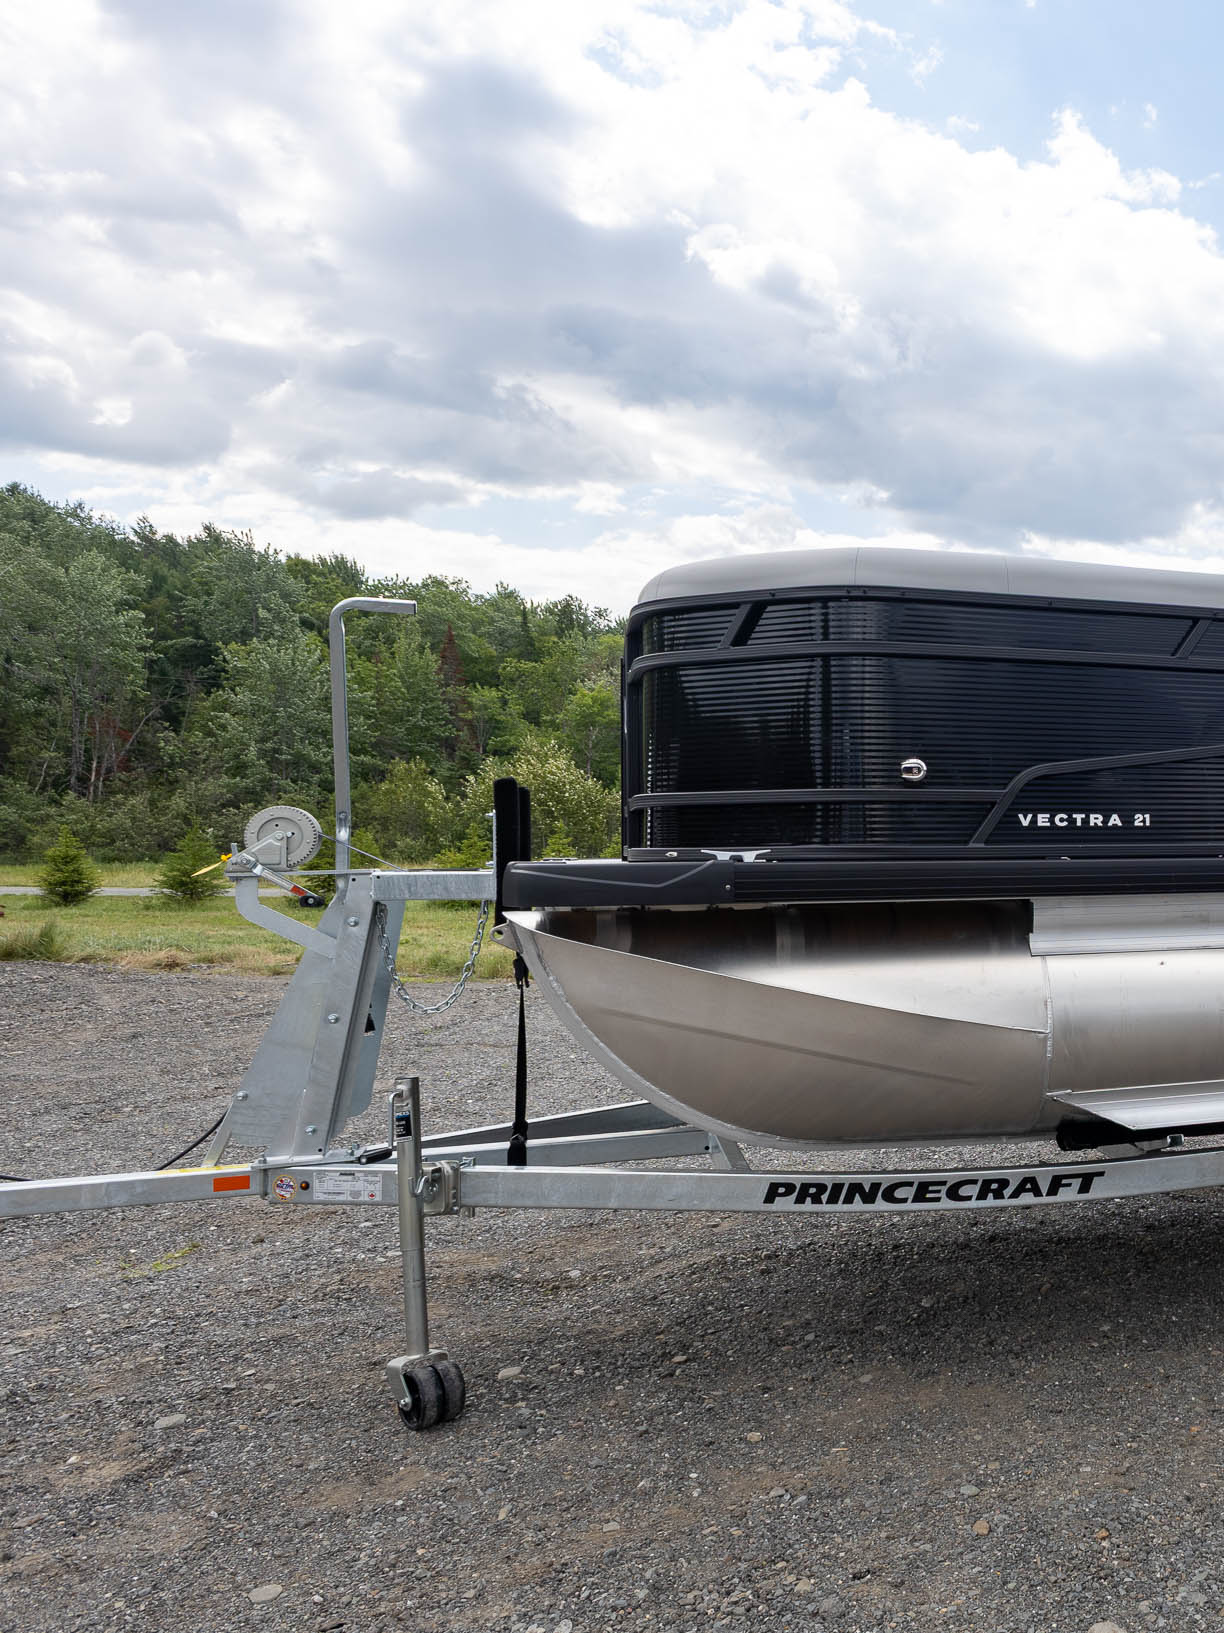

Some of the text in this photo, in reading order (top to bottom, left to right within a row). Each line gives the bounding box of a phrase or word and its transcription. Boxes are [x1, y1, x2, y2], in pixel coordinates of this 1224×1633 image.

[1018, 813, 1151, 827] VECTRA 21
[763, 1171, 1105, 1205] PRINCECRAFT
